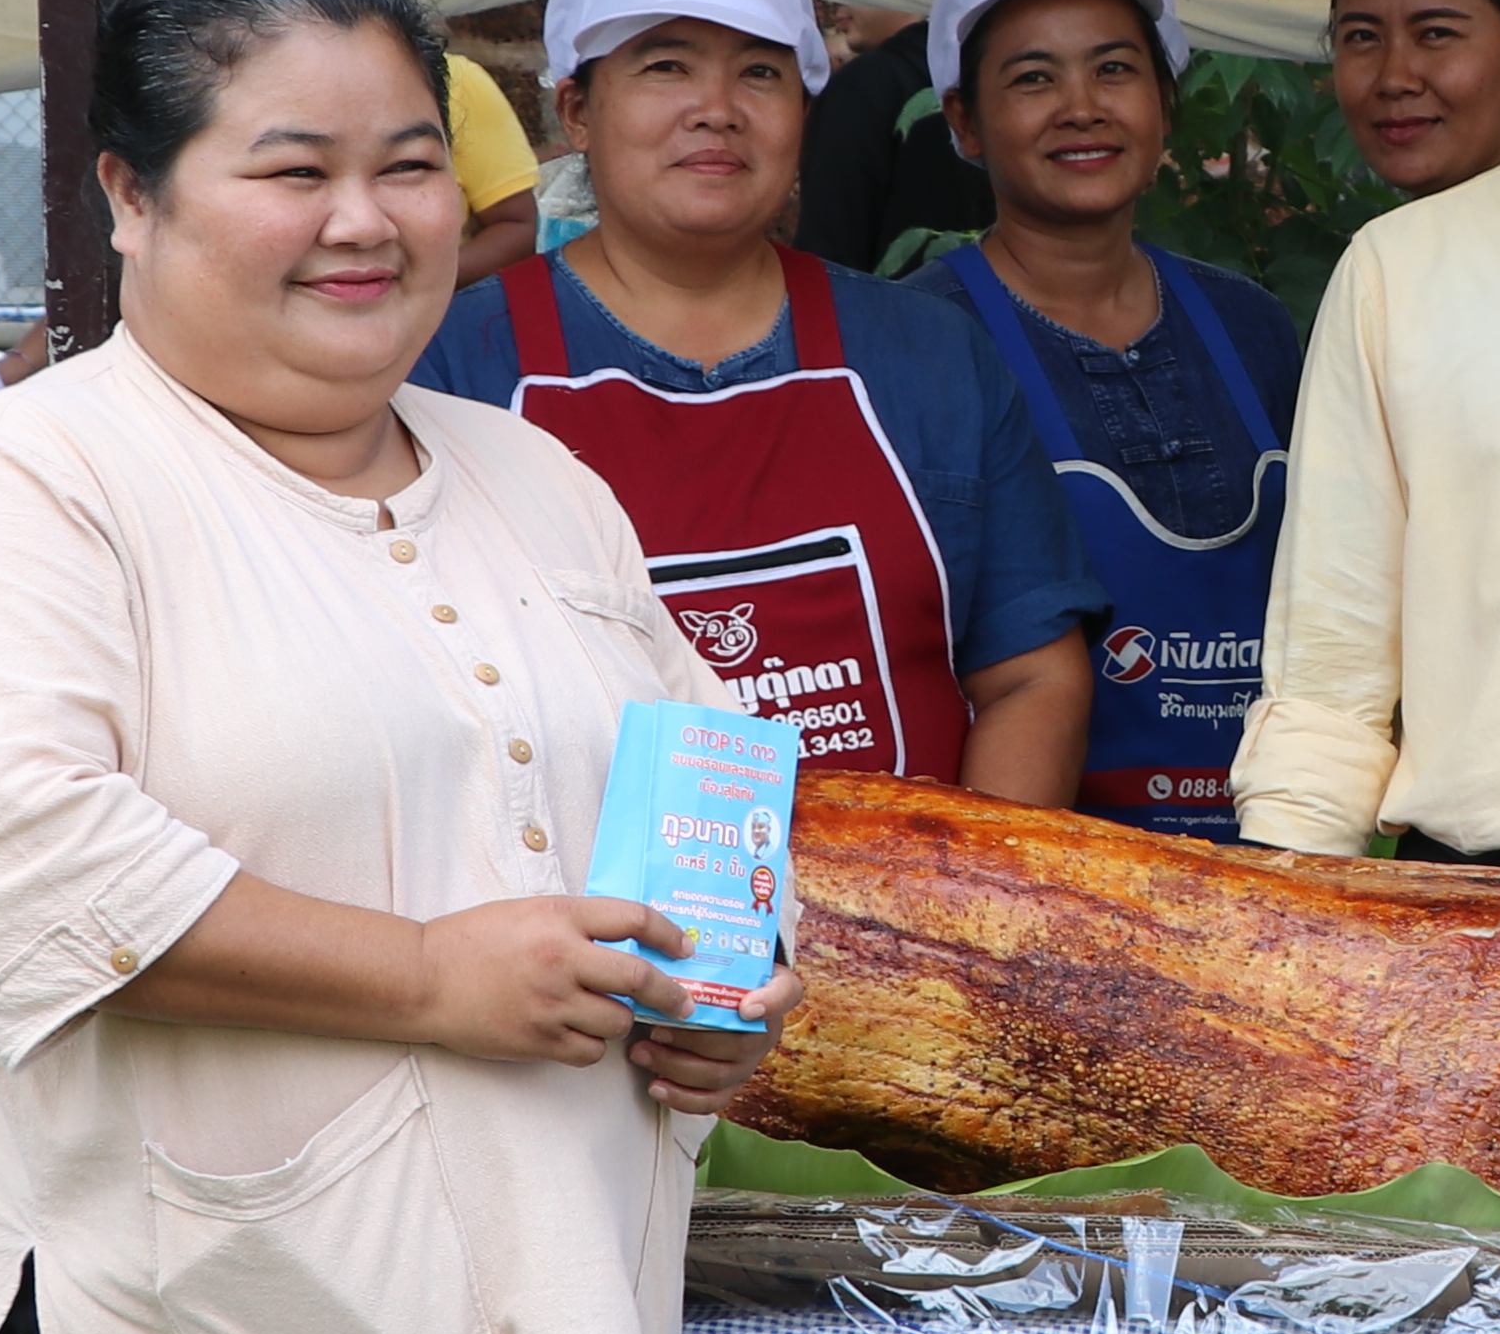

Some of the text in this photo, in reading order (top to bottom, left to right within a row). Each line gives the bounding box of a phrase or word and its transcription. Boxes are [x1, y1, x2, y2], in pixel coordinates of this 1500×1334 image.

[1160, 631, 1261, 669] เงินติด
[725, 656, 862, 715] มูตุ๊กตา
[682, 726, 732, 750] OTOP
[733, 736, 745, 755] 5
[1178, 777, 1236, 798] 088-0
[713, 860, 723, 873] 2
